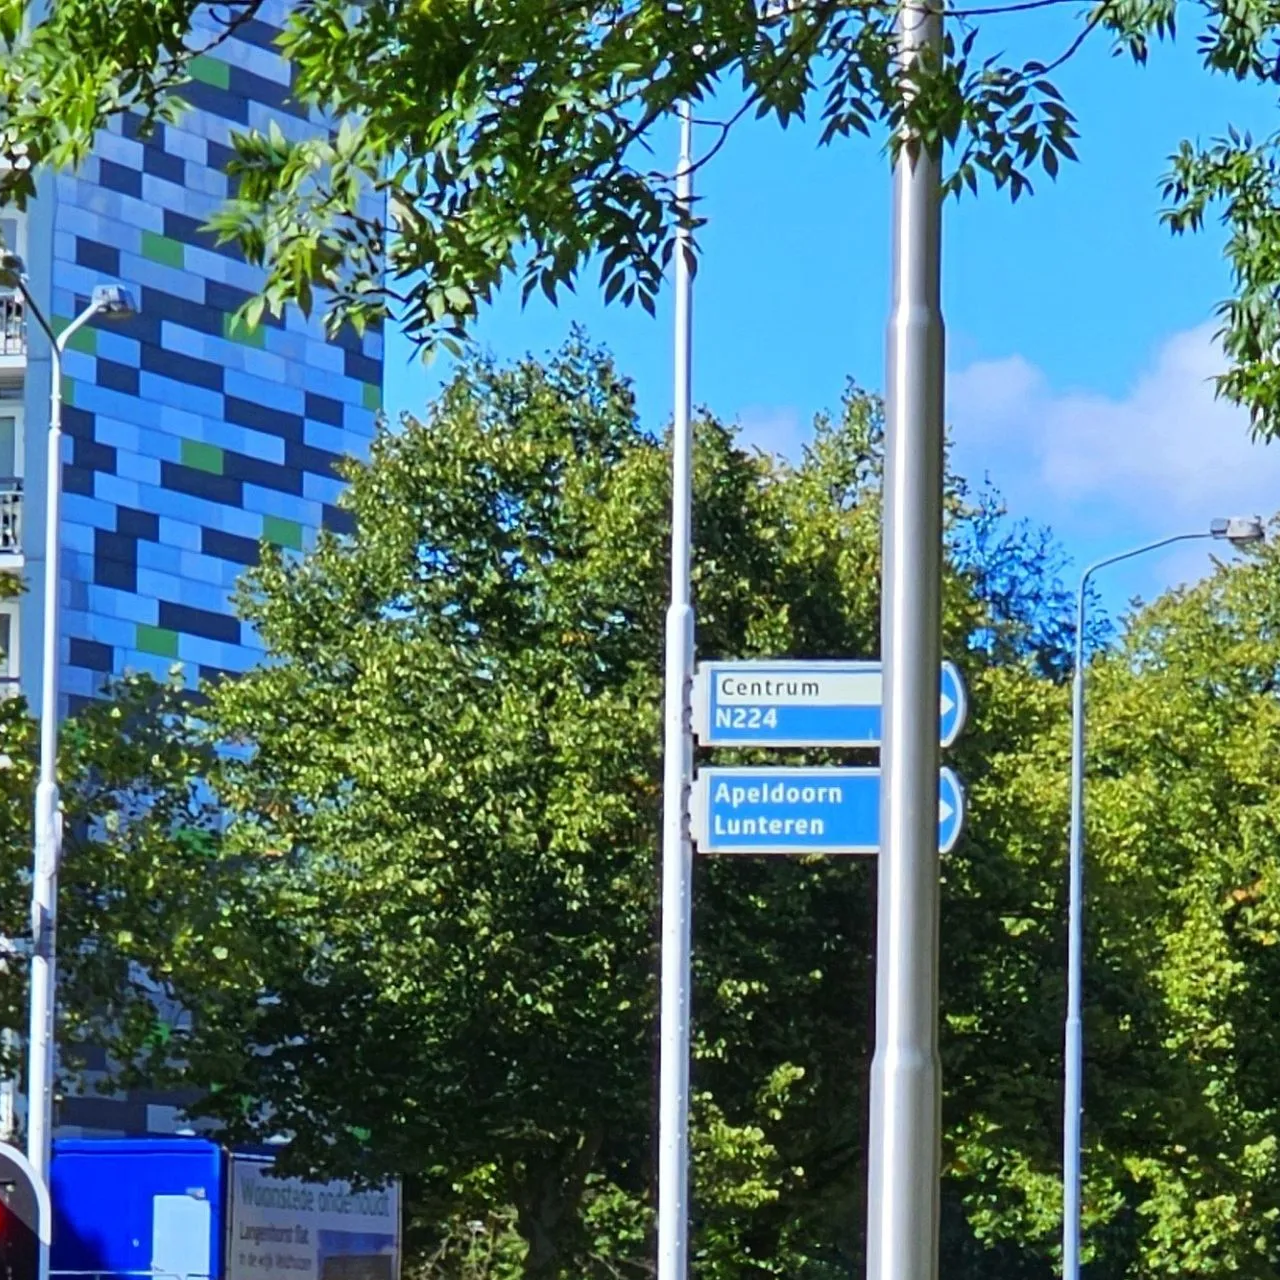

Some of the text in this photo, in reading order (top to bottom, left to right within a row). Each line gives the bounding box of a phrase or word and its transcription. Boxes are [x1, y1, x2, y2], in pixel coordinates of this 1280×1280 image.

[721, 678, 819, 696] Centrum
[716, 708, 777, 730] N224
[714, 783, 843, 808] Apeldoorn
[715, 816, 824, 835] Lunteren
